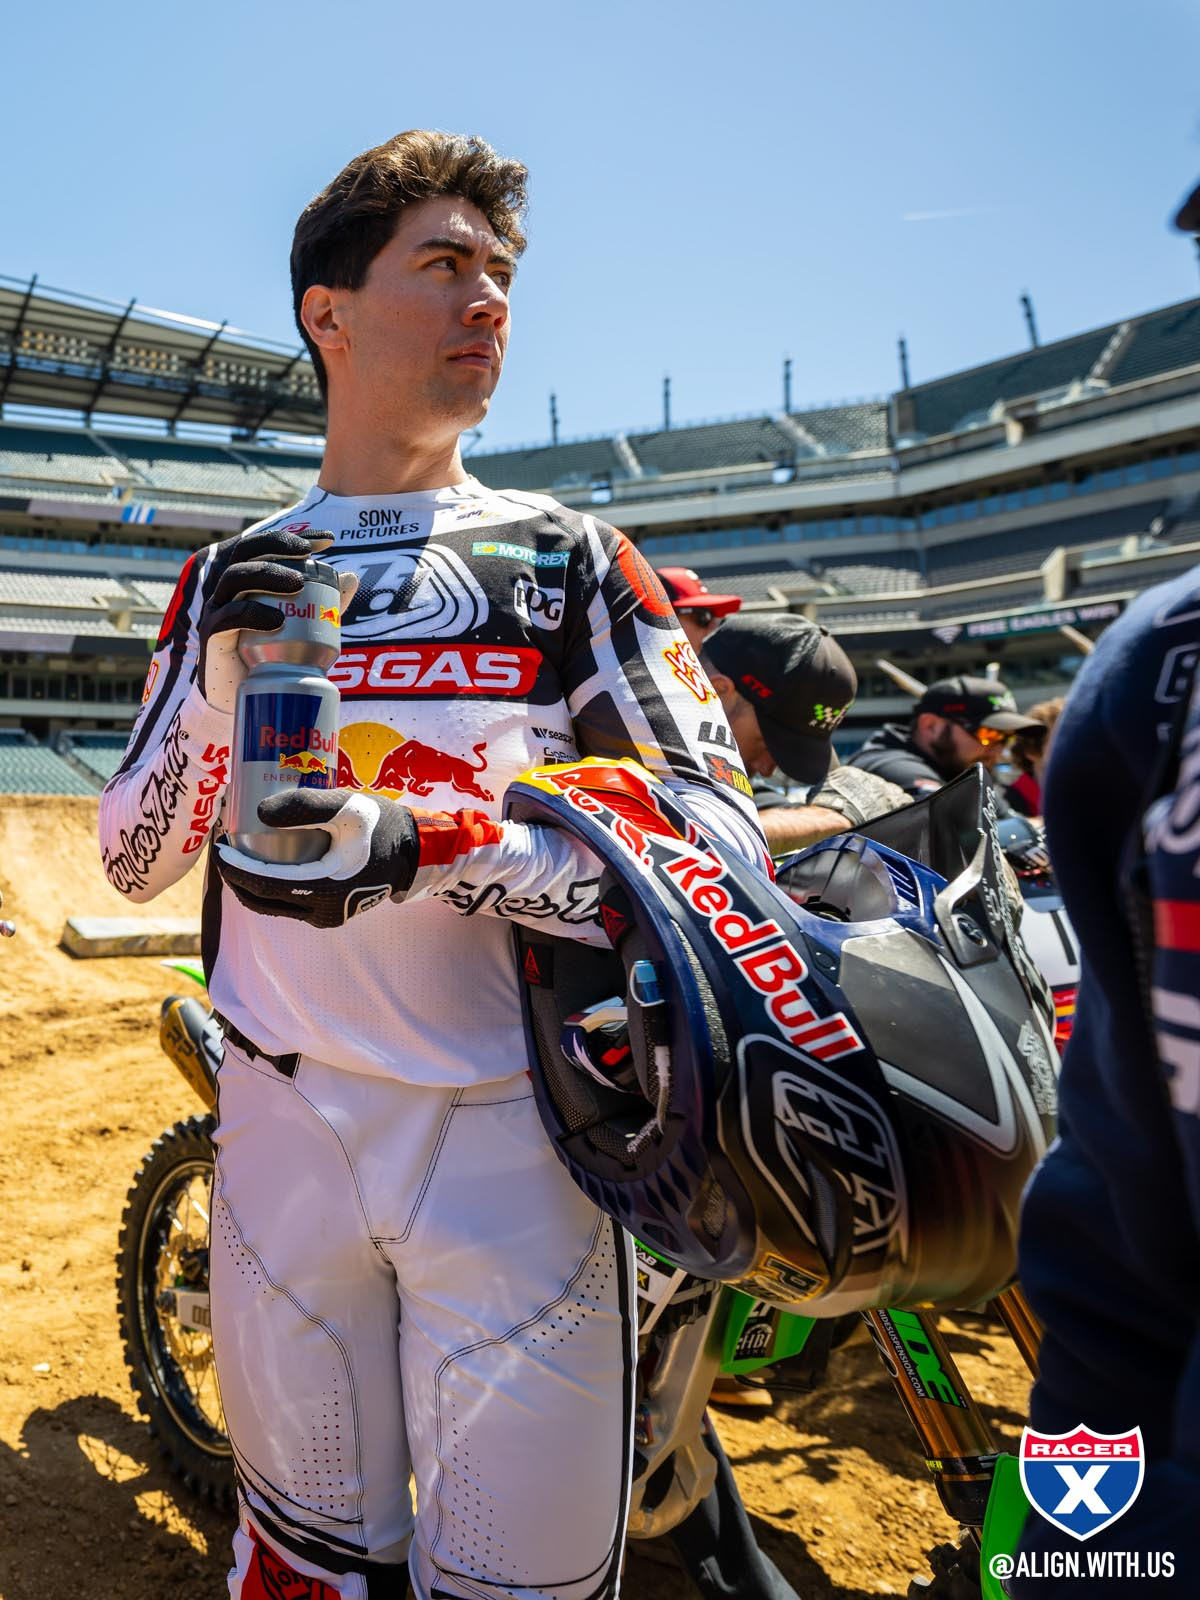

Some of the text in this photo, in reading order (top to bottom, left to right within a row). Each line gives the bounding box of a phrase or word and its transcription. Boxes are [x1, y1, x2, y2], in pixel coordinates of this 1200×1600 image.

[359, 510, 403, 528] SONY
[340, 522, 420, 540] PICTURES
[498, 544, 570, 567] MOTOREX
[285, 602, 316, 620] Bull
[966, 618, 1008, 638] FREE
[328, 651, 521, 690] SGAS
[260, 724, 338, 755] Red Bull
[263, 773, 307, 784] ENERGY
[664, 850, 862, 1062] Red Bull
[876, 1309, 926, 1398] RIDESUSPENSION.COM
